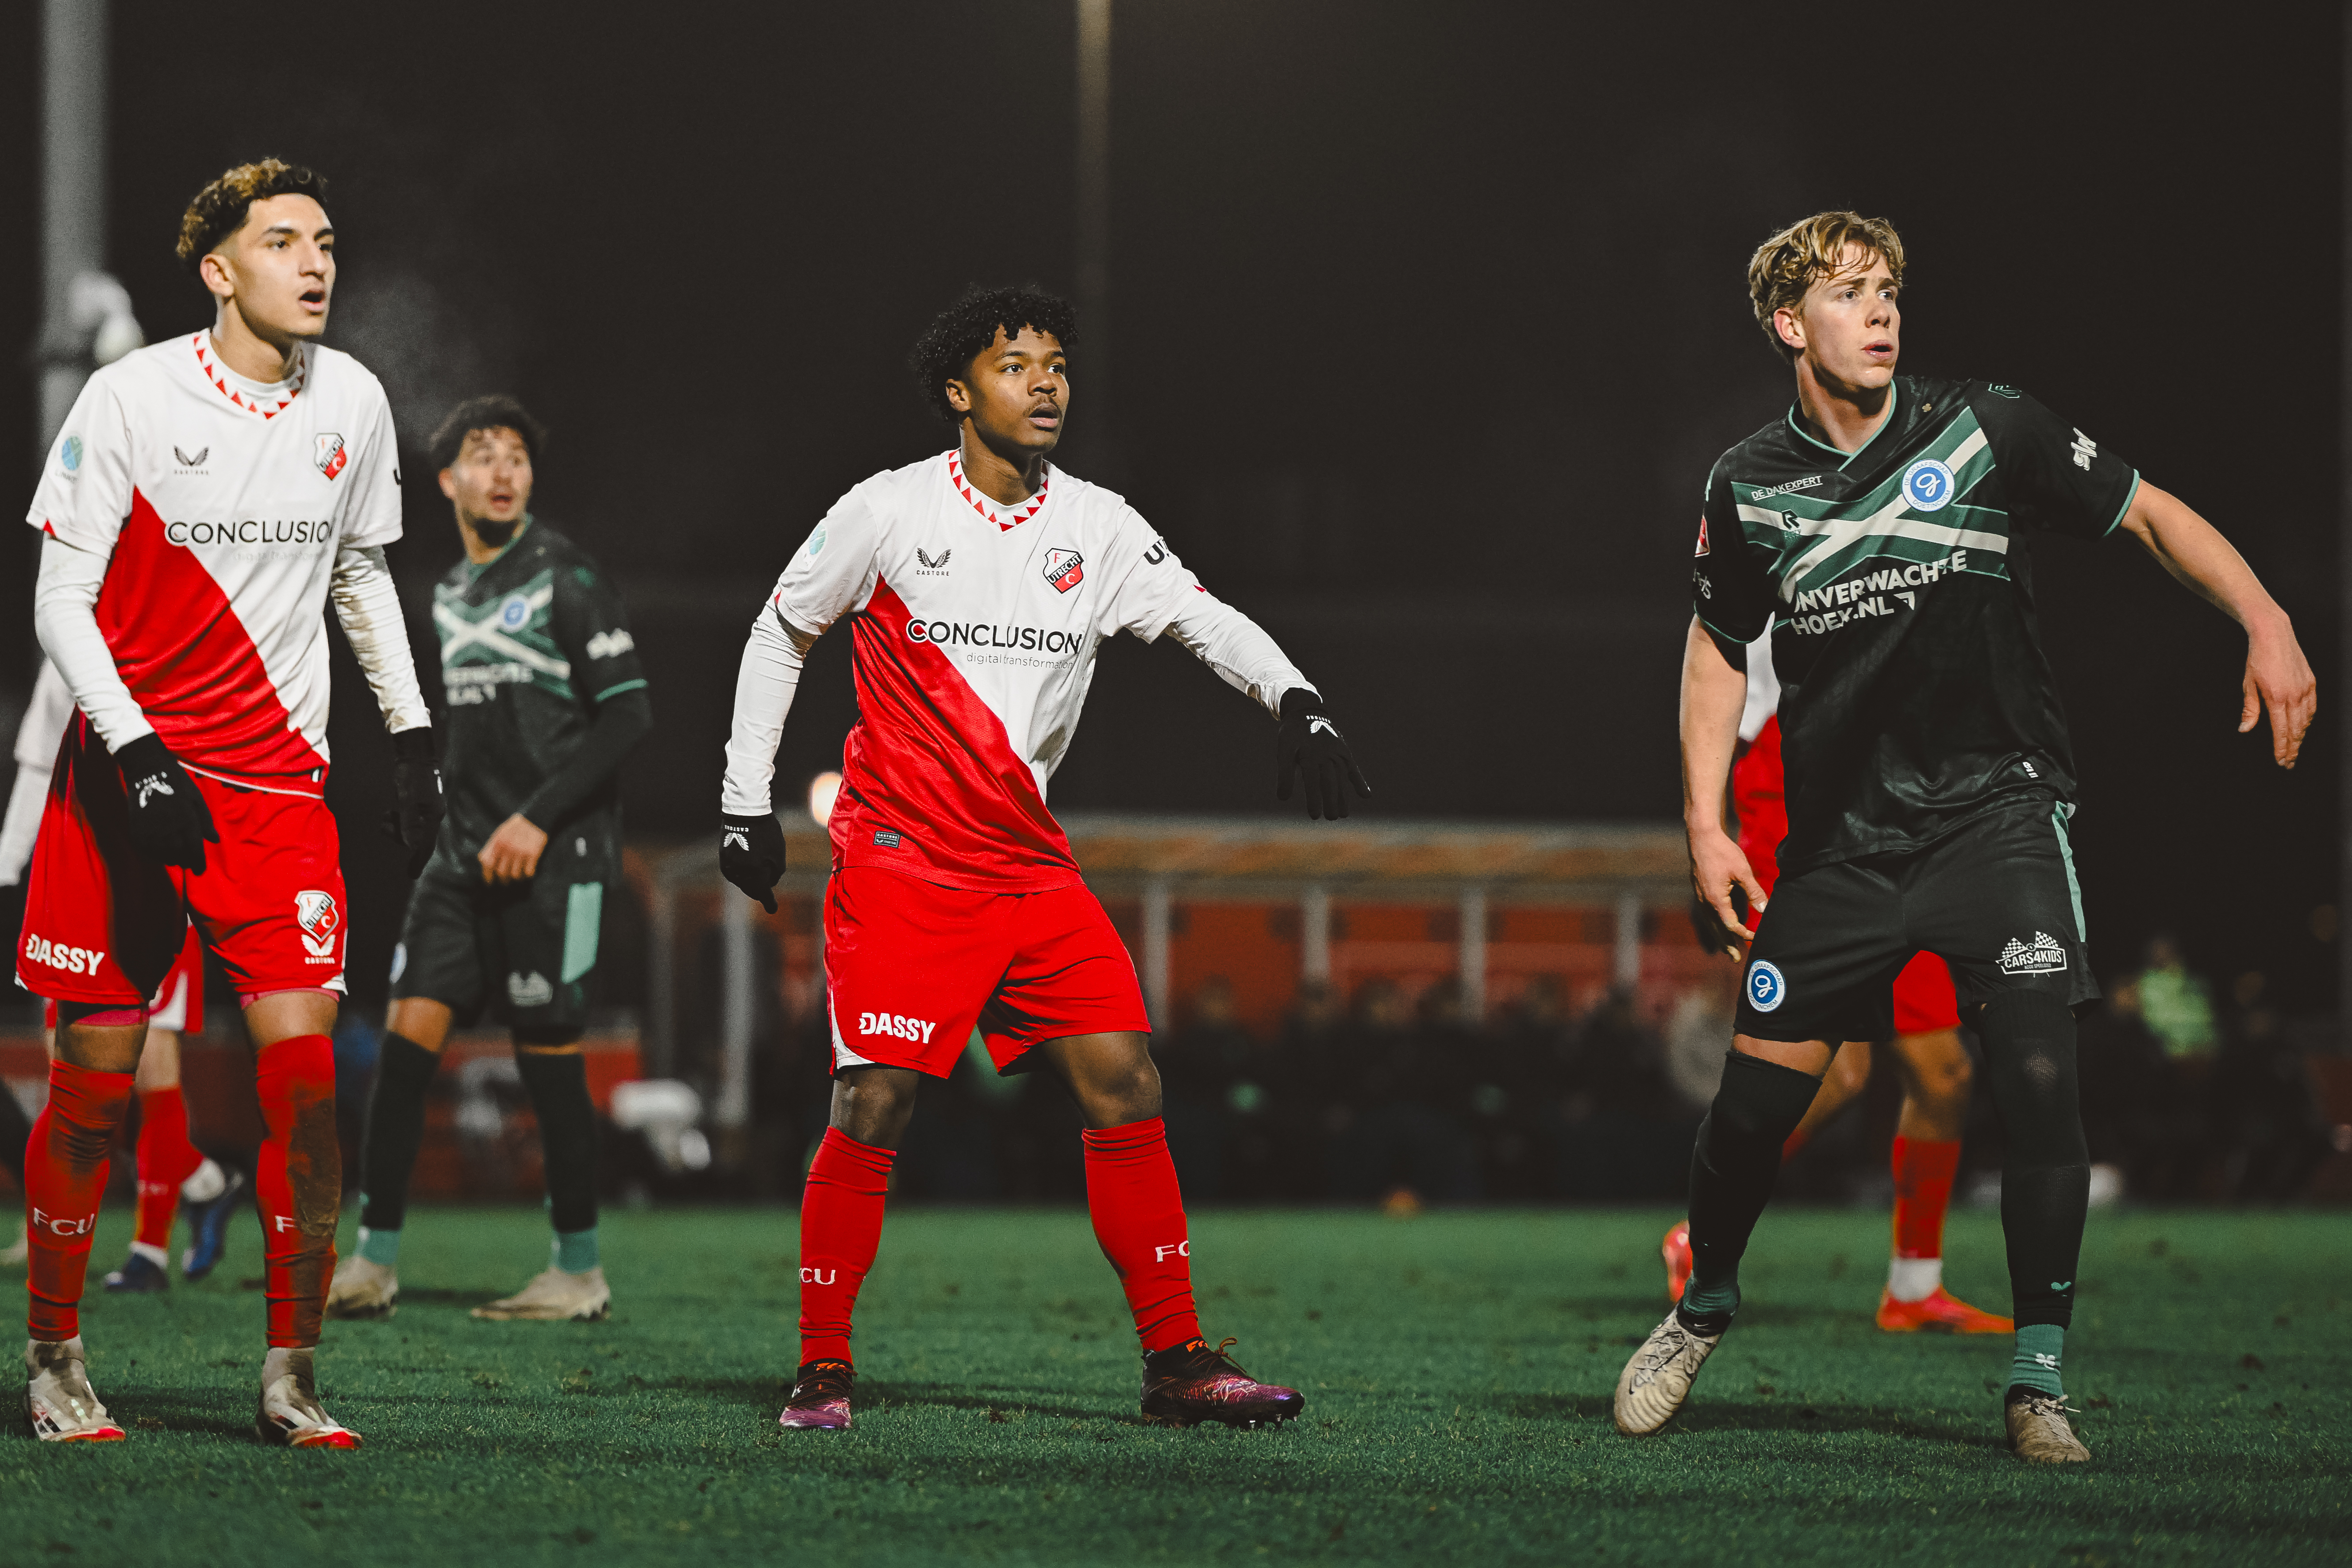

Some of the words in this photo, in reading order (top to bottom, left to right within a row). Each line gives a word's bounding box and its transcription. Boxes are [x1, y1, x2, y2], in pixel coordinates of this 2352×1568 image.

[1908, 462, 1948, 475] GRAAFSCHAP
[1751, 489, 1765, 499] DE
[1766, 475, 1822, 495] DAKEXPERT
[1912, 490, 1951, 509] DOETINCHEM
[168, 520, 333, 544] CONCLUSIO
[1047, 554, 1081, 583] UTRECHT
[1054, 553, 1061, 563] F
[1065, 573, 1075, 584] C
[1794, 550, 1967, 613] NVERWACHTE
[1790, 597, 1894, 635] HOEX.NL
[908, 619, 1082, 655] CONCLUSION
[966, 652, 1002, 664] digital
[1004, 655, 1073, 669] transformation
[321, 916, 331, 929] C
[26, 933, 105, 977] DASSY
[2005, 950, 2062, 968] CARS4KIDS
[1754, 963, 1783, 986] GRAAFSCHAP
[858, 1012, 936, 1044] DASSY
[33, 1207, 95, 1236] FCU
[1155, 1240, 1190, 1263] FC
[799, 1267, 836, 1285] CU
